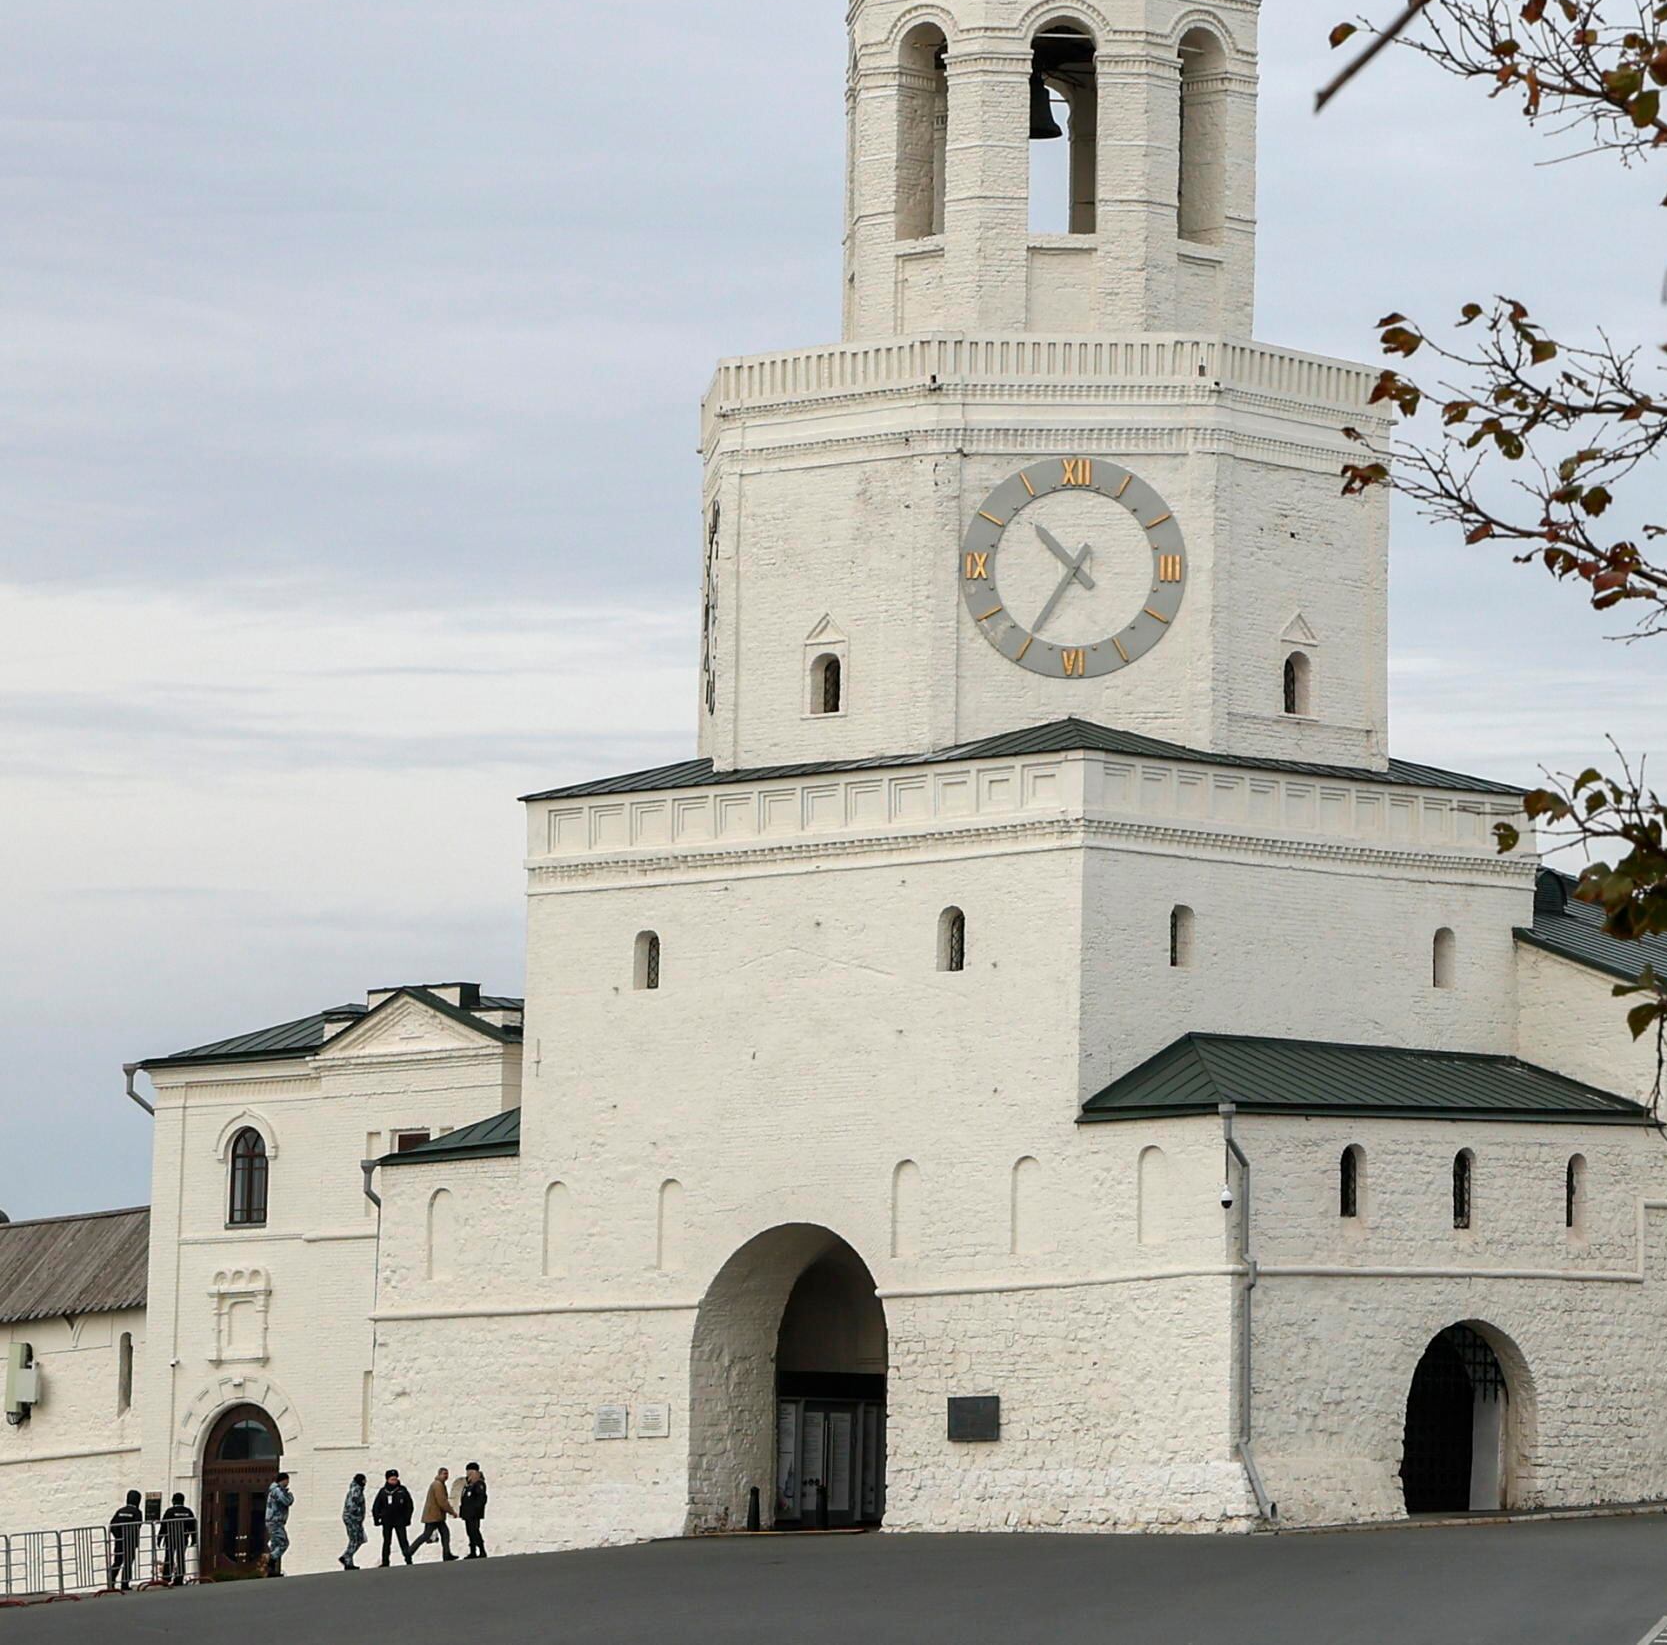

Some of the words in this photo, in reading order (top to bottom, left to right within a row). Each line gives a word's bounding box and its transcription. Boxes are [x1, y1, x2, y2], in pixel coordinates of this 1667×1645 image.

[1061, 458, 1092, 486] XII
[965, 552, 989, 580] IX
[1158, 554, 1182, 582] III
[1061, 649, 1086, 676] VI
